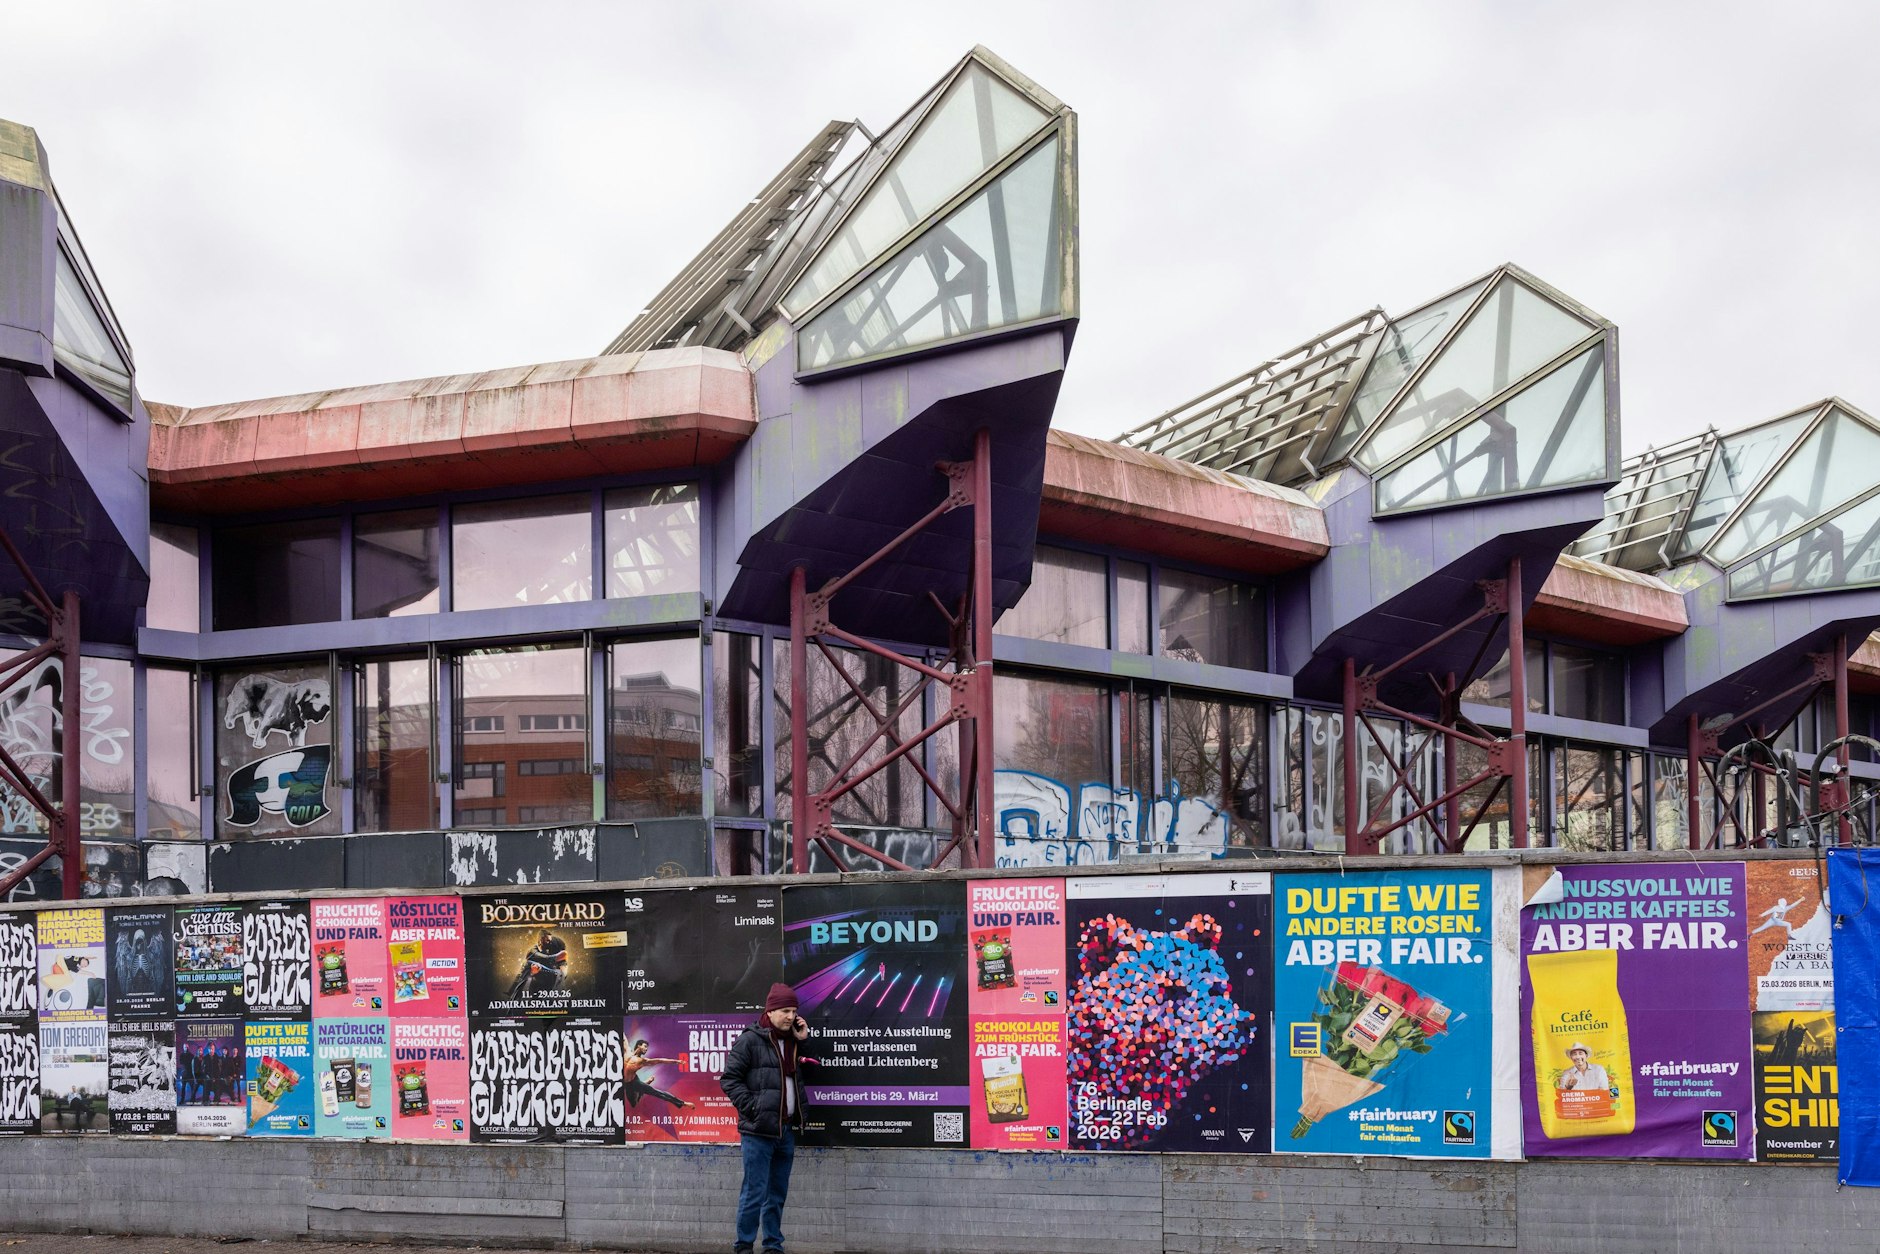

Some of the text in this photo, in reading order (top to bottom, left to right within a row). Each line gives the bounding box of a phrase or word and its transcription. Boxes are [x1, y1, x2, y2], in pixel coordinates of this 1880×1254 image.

[1789, 868, 1819, 876] dEUS
[1685, 877, 1733, 896] WIE
[972, 886, 1060, 901] FRUCHTIG,
[1286, 884, 1480, 915] DUFTE WIE
[315, 904, 382, 917] FRUCHTIG,
[389, 901, 457, 917] KÖSTLICH
[972, 900, 1060, 912] SCHOKOLADIG.
[1533, 900, 1735, 920] ANDERE KAFFEES.
[37, 909, 104, 921] MALUGI
[190, 911, 235, 924] we are
[481, 902, 606, 924] BODYGUARD
[973, 912, 1060, 927] UND FAIR.
[37, 919, 104, 929] HARDCORE
[315, 917, 382, 927] SCHOKOLADIG.
[391, 917, 459, 928] WIE ANDERE.
[734, 915, 775, 926] Liminals
[1286, 914, 1482, 936] ANDERE ROSEN.
[37, 928, 105, 945] HAPPINESS
[173, 918, 242, 942] Scientists
[316, 927, 382, 940] UND FAIR.
[390, 928, 460, 941] ABER FAIR.
[811, 920, 939, 944] BEYOND
[1532, 922, 1738, 951] ABER FAIR.
[1285, 937, 1483, 966] ABER FAIR.
[1762, 943, 1812, 952] WORST
[1786, 952, 1827, 960] VERSUS
[1774, 961, 1789, 969] IN
[1795, 961, 1805, 969] A
[1761, 980, 1821, 988] 25.03.2026 BERLIN,
[538, 990, 571, 998] 29.03.26
[488, 999, 606, 1009] ADMIRALSPALAST BERLIN
[1561, 1009, 1593, 1023] Café
[122, 1023, 127, 1031] IS
[142, 1022, 154, 1031] HELL
[154, 1022, 159, 1030] IS
[245, 1024, 309, 1037] DUFTE WIE
[319, 1022, 385, 1035] NATÜRLICH
[395, 1025, 464, 1038] FRUCHTIG,
[823, 1026, 951, 1039] immersive Ausstellung
[974, 1021, 1060, 1033] SCHOKOLADE
[1550, 1019, 1609, 1033] Intención
[41, 1026, 107, 1048] TOM GREGORY
[245, 1037, 309, 1046] ANDERE ROSEN.
[318, 1036, 386, 1045] MIT GUARANA.
[395, 1038, 465, 1047] SCHOKOLADIG.
[974, 1032, 1061, 1043] ZUM FRÜHSTÜCK.
[245, 1045, 310, 1058] ABER FAIR.
[318, 1046, 387, 1059] UND FAIR.
[833, 1041, 917, 1052] im verlassenen
[975, 1043, 1062, 1057] ABER FAIR.
[396, 1048, 465, 1060] UND FAIR.
[678, 1052, 730, 1073] REVOL
[819, 1056, 938, 1069] tadtbad Lichtenberg
[1640, 1061, 1739, 1076] #fairbruary
[1076, 1082, 1102, 1095] 76.
[1653, 1078, 1714, 1087] Einen Monat
[814, 1091, 938, 1103] Verlängert bis 29. März!
[1653, 1088, 1722, 1097] fair einkaufen
[470, 1079, 546, 1129] GLÜCK
[545, 1079, 625, 1129] GLÜCK
[1077, 1096, 1152, 1110] Berlinale
[1137, 1111, 1167, 1126] Feb
[1348, 1107, 1438, 1123] #fairbruary
[1077, 1125, 1121, 1140] 2026
[1360, 1124, 1414, 1132] Einen Monat
[1360, 1133, 1421, 1142] fair einkaufen
[1766, 1139, 1836, 1149] November 7
